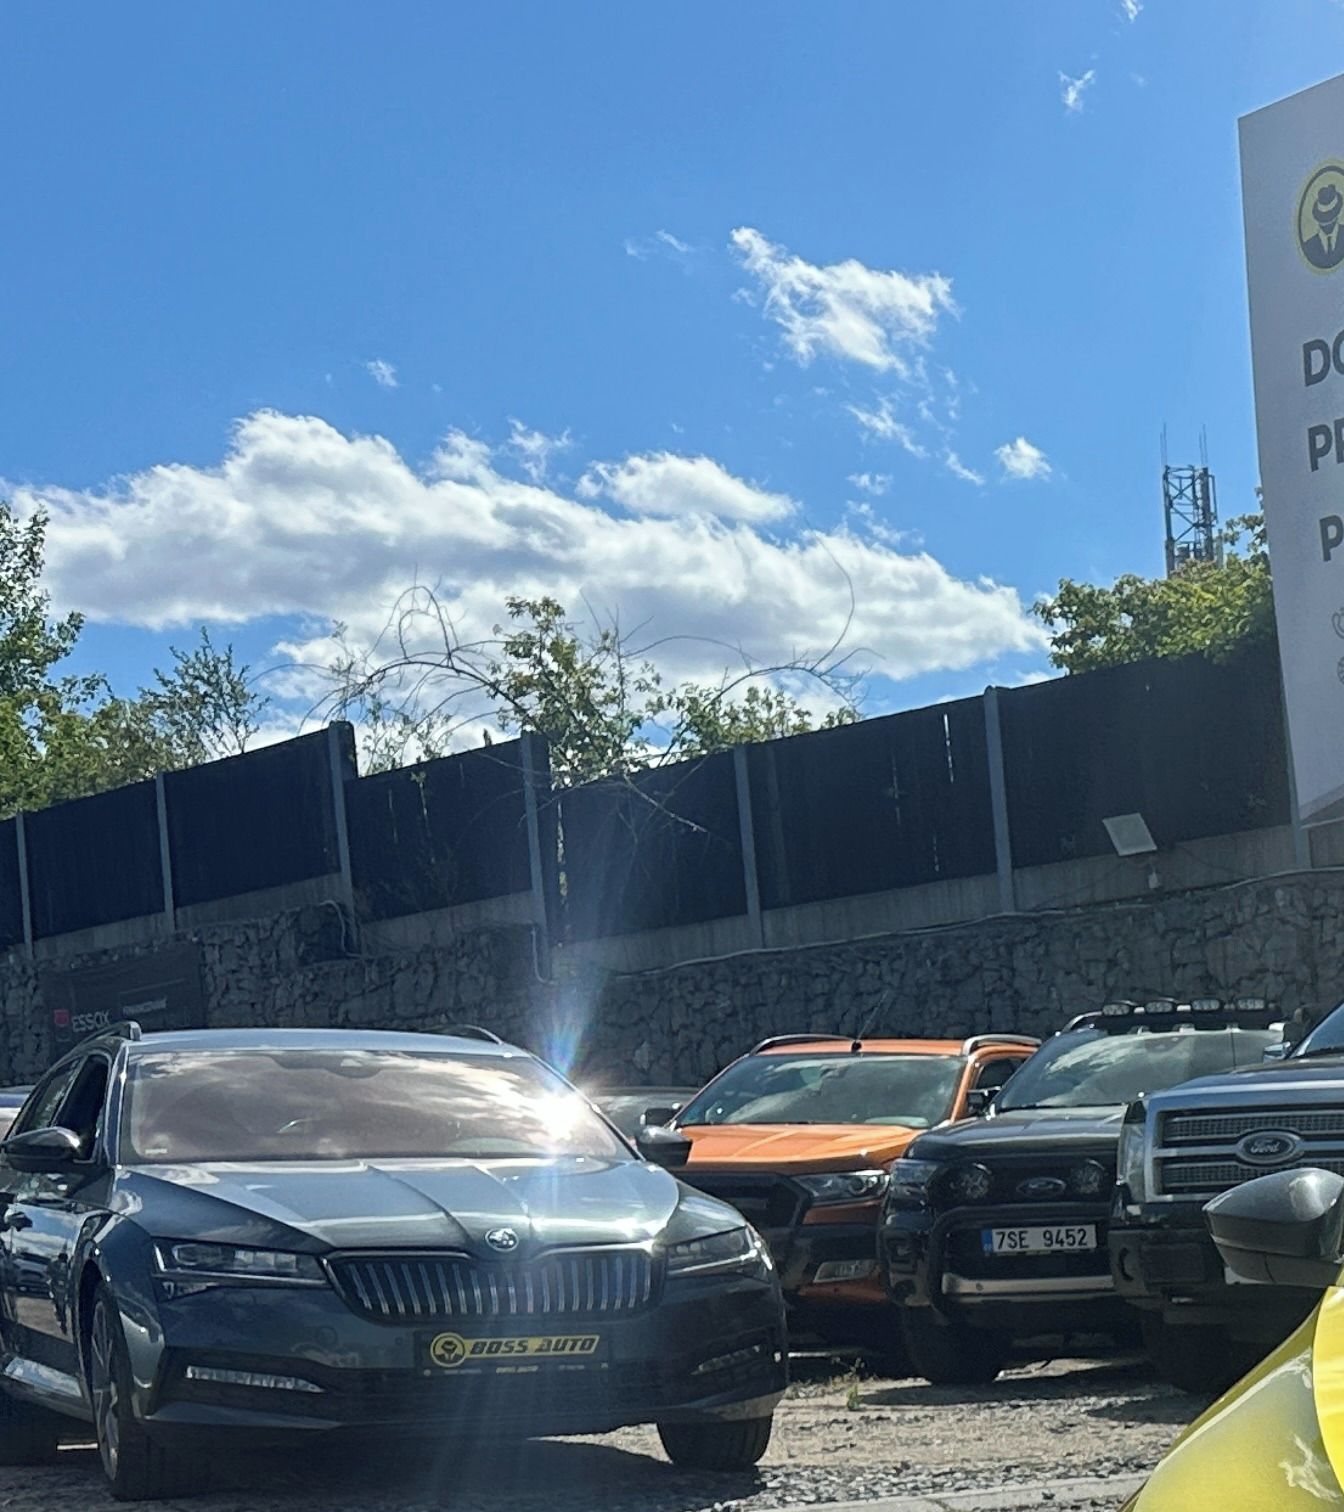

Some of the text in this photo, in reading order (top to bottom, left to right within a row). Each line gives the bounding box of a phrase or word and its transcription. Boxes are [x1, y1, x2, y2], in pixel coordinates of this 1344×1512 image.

[72, 1010, 111, 1032] ESSOX
[1250, 1137, 1280, 1154] Ford
[996, 1230, 1029, 1249] 7SE
[1043, 1228, 1088, 1247] 9452
[470, 1337, 596, 1355] BOSS AUTO
